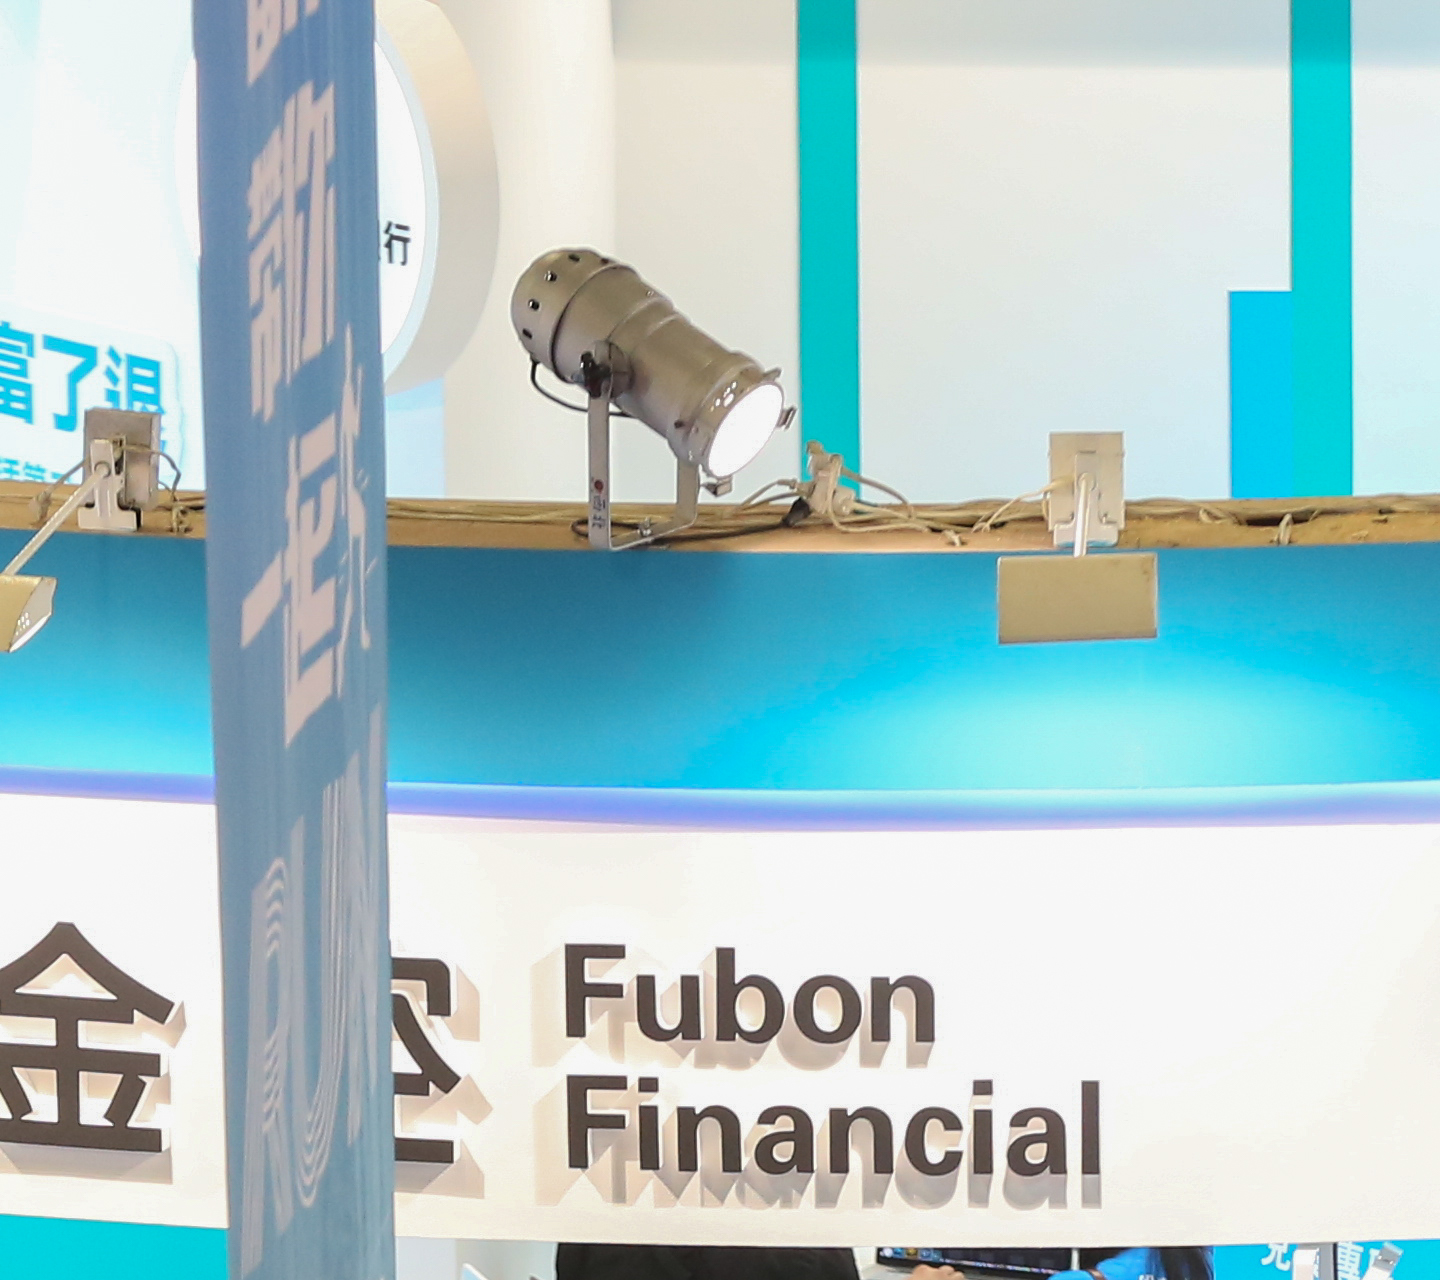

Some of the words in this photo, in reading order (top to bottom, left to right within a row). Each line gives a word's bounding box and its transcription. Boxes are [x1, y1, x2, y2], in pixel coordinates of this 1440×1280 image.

[380, 220, 411, 267] 行
[565, 944, 935, 1045] Fubon
[566, 1074, 1100, 1175] Financial
